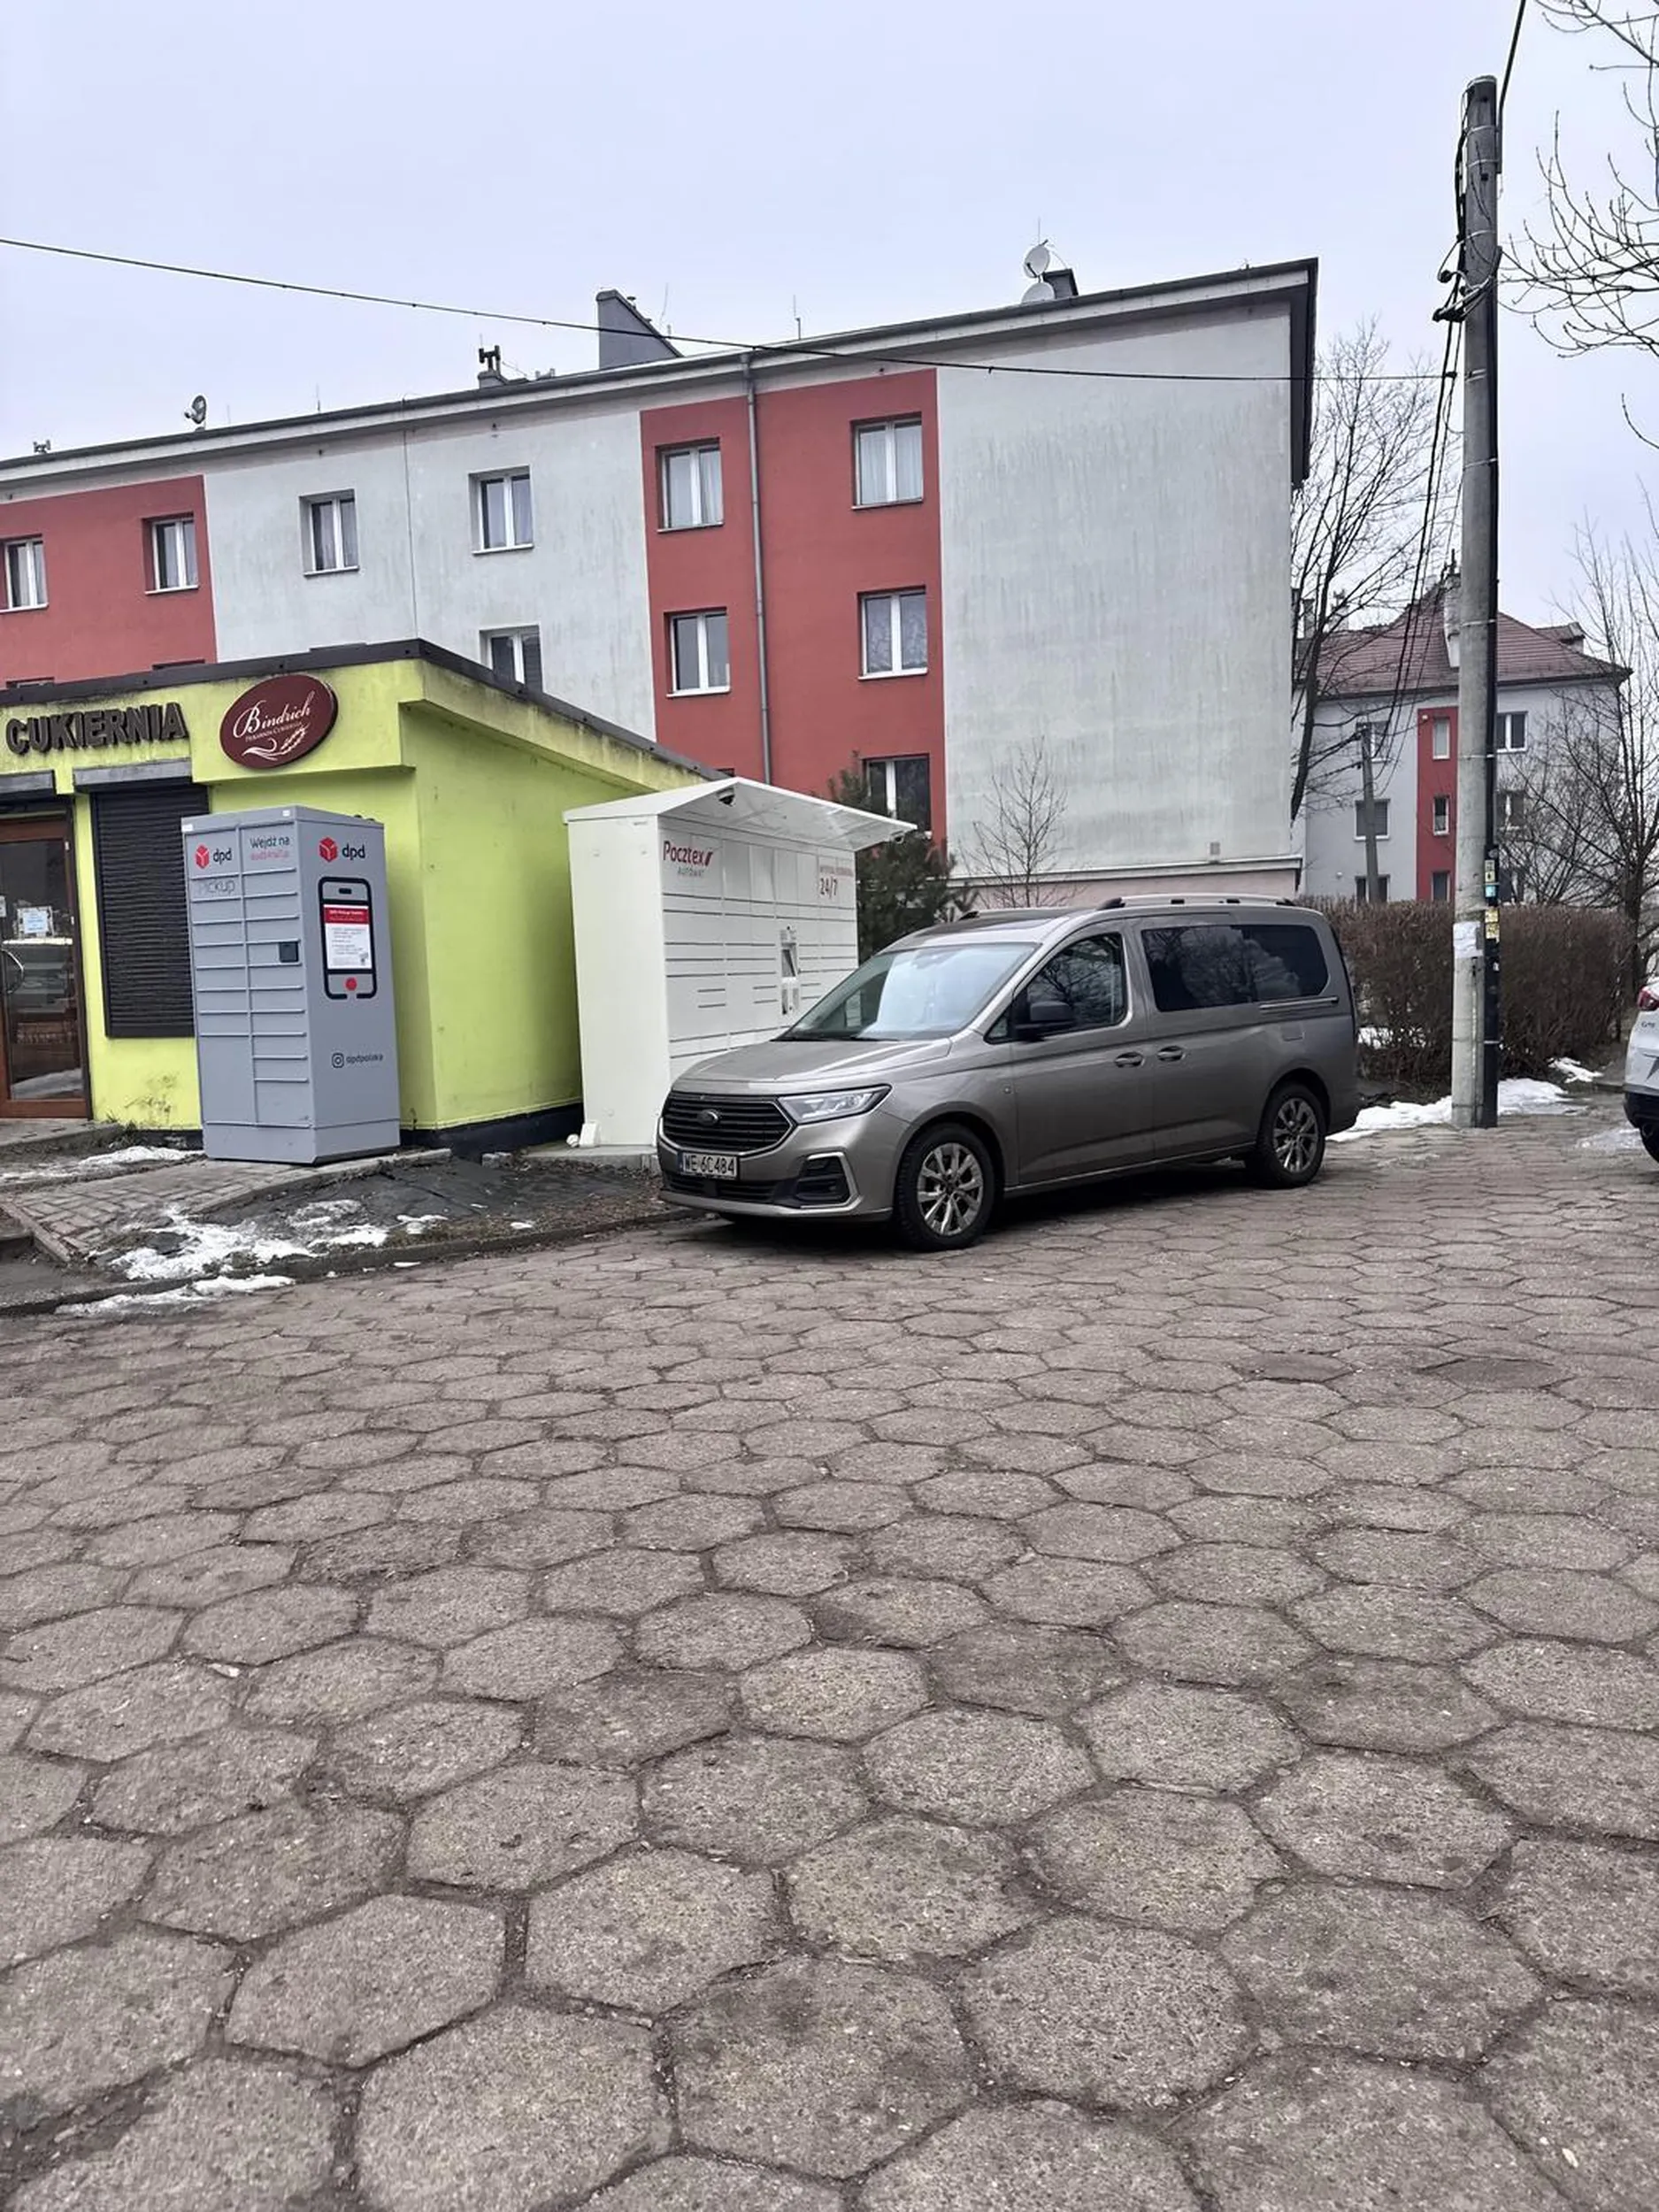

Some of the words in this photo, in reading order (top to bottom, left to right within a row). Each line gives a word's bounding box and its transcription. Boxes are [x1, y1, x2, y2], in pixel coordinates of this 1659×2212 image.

[233, 690, 316, 738] Bindrich
[5, 703, 190, 755] CUKIERNIA
[279, 835, 291, 846] na
[342, 843, 366, 860] dpd
[212, 848, 233, 865] dpd
[664, 840, 704, 866] Pocztex
[820, 875, 838, 899] 24/7
